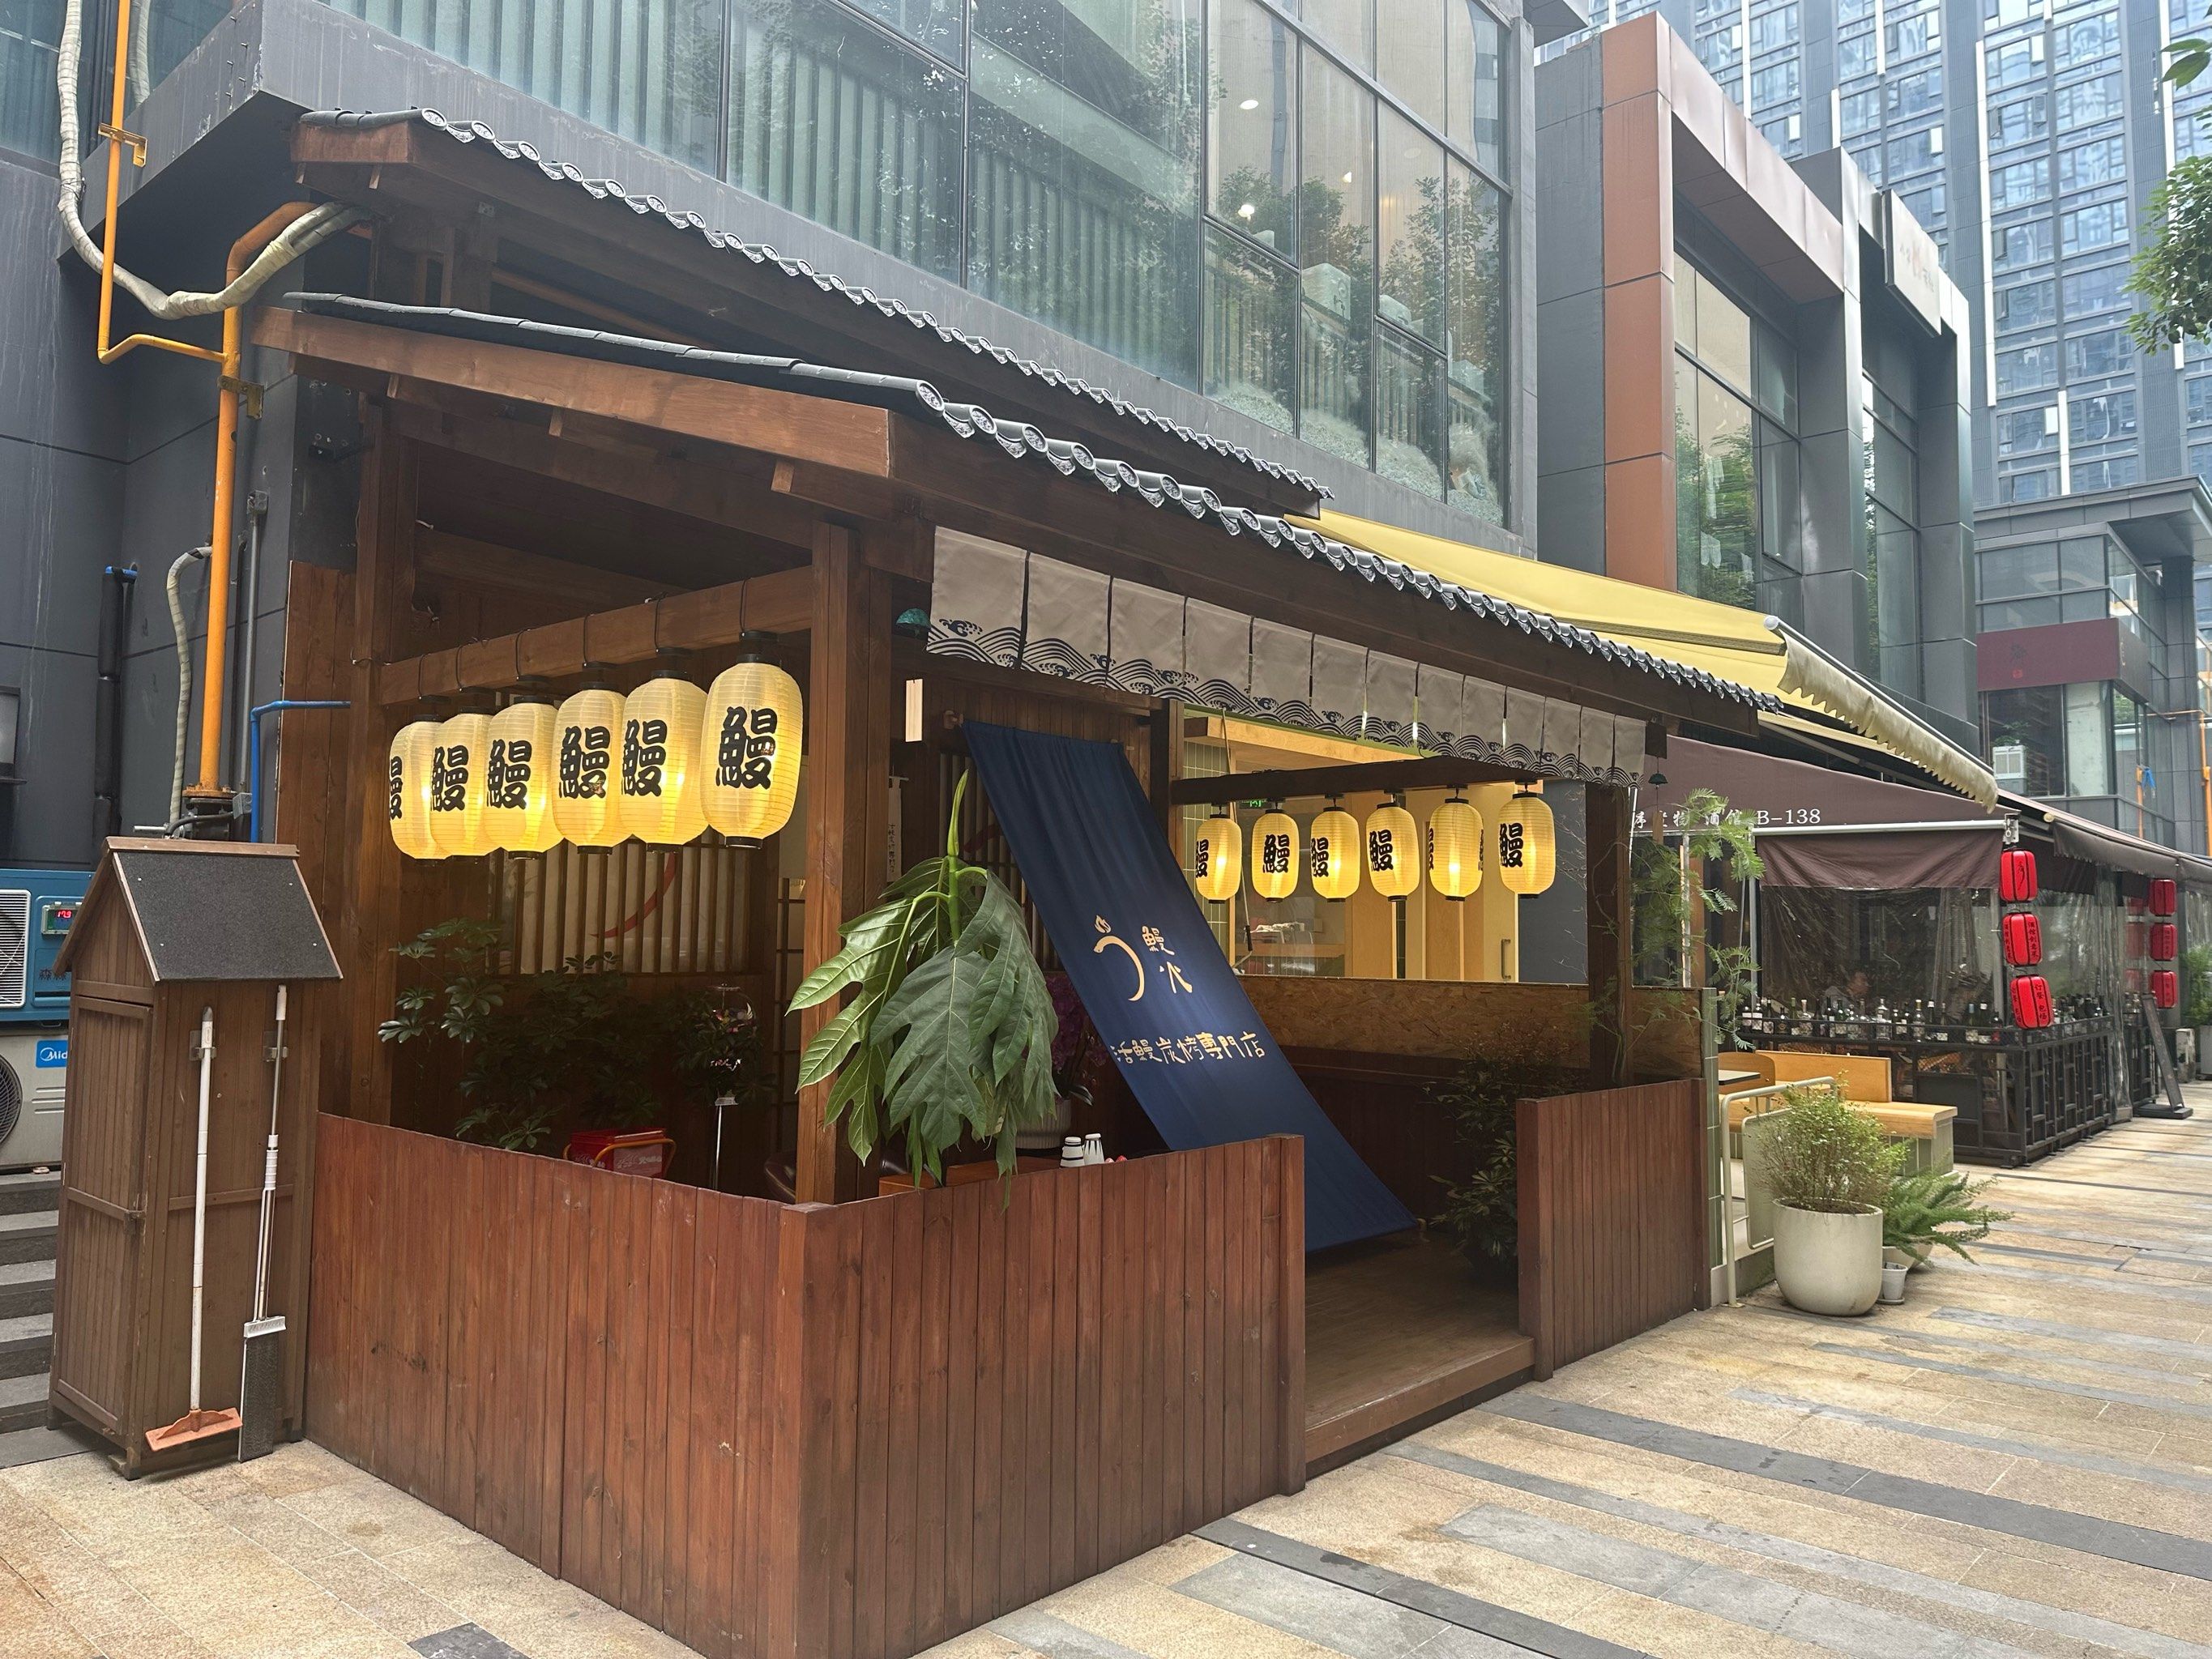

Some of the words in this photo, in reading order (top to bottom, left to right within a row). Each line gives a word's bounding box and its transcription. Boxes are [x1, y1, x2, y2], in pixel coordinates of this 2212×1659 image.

[486, 739, 532, 809] 鰻
[558, 726, 610, 799] 鰻
[621, 719, 667, 797] 鰻
[716, 706, 778, 789] 鰻
[1757, 808, 1821, 825] B-138
[1262, 834, 1291, 874] 鰻
[44, 1049, 68, 1060] Mid
